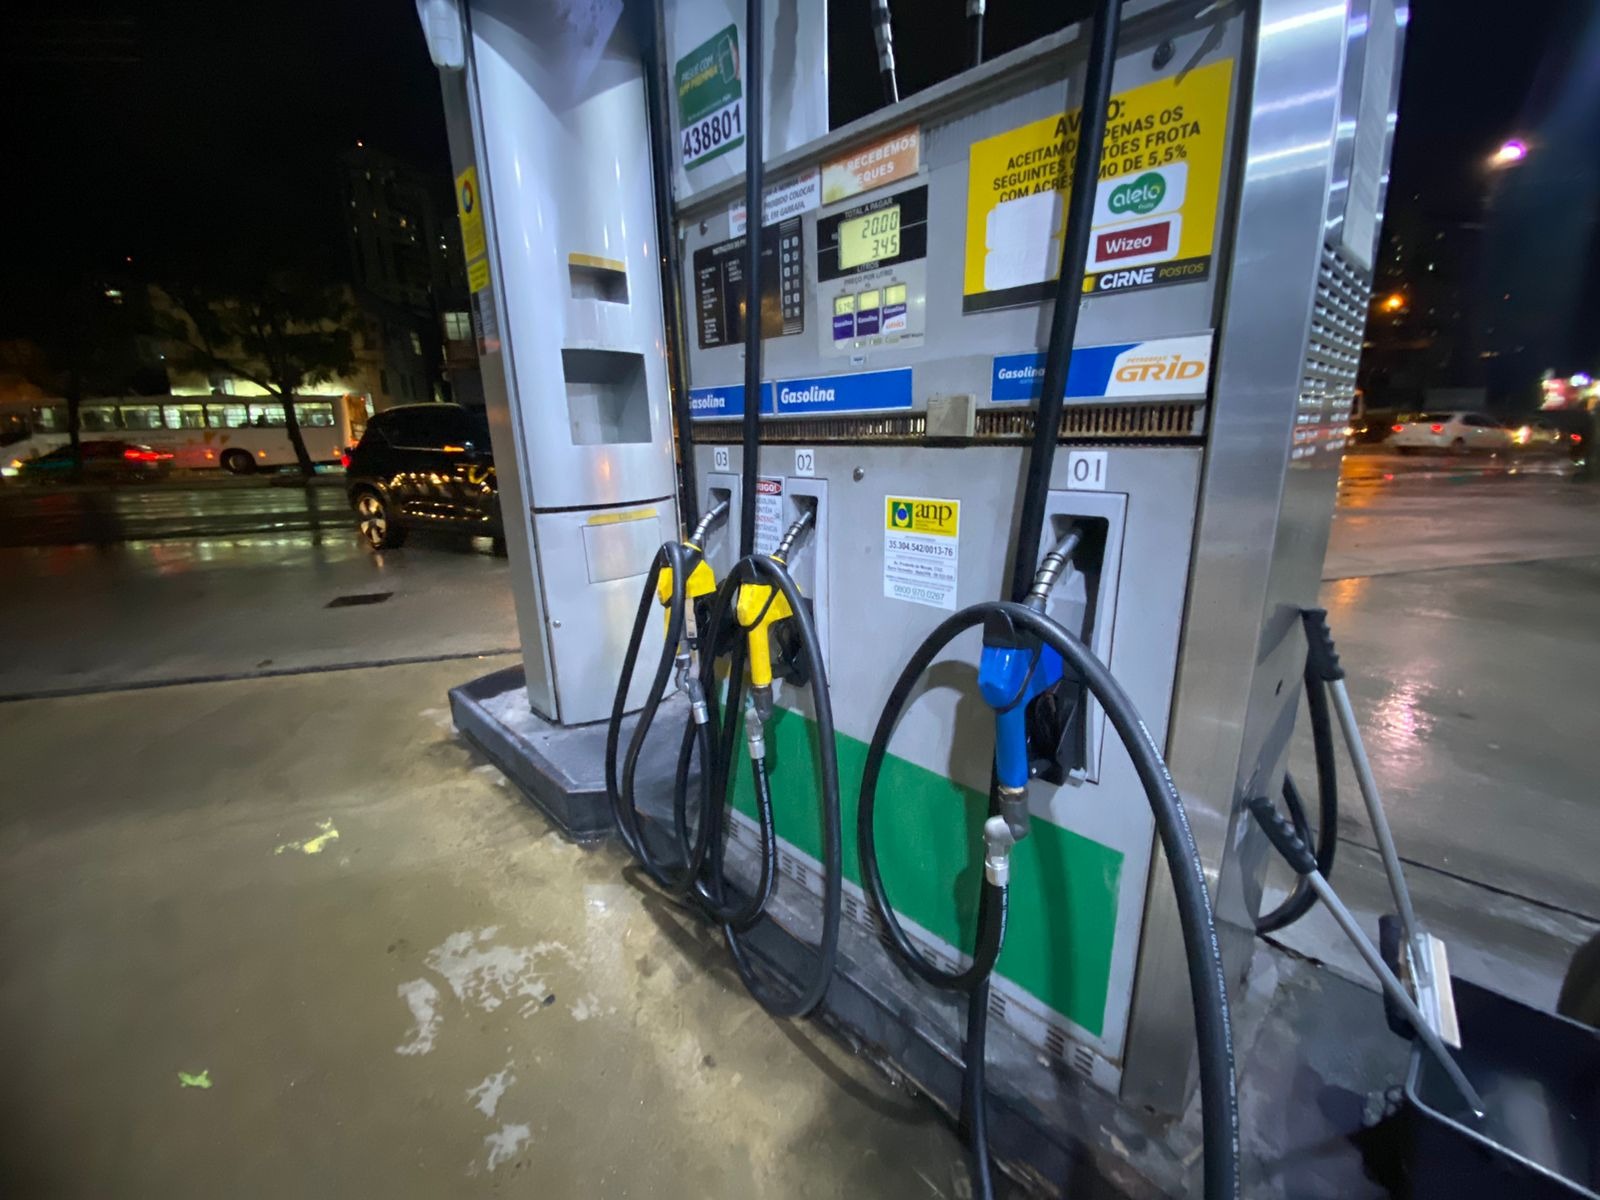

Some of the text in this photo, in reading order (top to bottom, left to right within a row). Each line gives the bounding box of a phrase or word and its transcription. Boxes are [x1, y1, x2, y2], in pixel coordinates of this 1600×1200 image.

[683, 103, 741, 158] 438801
[1007, 106, 1183, 170] ACEITAMO PENAS OS
[847, 134, 917, 170] RECEBEMOS
[993, 158, 1066, 191] SEGUINTES
[1145, 121, 1200, 149] FROTA
[856, 161, 895, 187] EQUES
[1000, 185, 1029, 203] COM
[1123, 155, 1142, 173] DE
[1148, 144, 1187, 167] 5,5%
[789, 184, 815, 201] COLOCAR
[1113, 183, 1160, 207] alelo
[845, 208, 863, 219] TOTAL
[870, 197, 894, 211] PAGAR
[1106, 236, 1152, 254] Wizeo
[1100, 263, 1204, 290] CIRNE POSTOS
[998, 366, 1046, 380] Gasolina
[781, 386, 835, 405] Gasolina
[715, 451, 1101, 482] 03 02 01
[915, 503, 953, 527] anp
